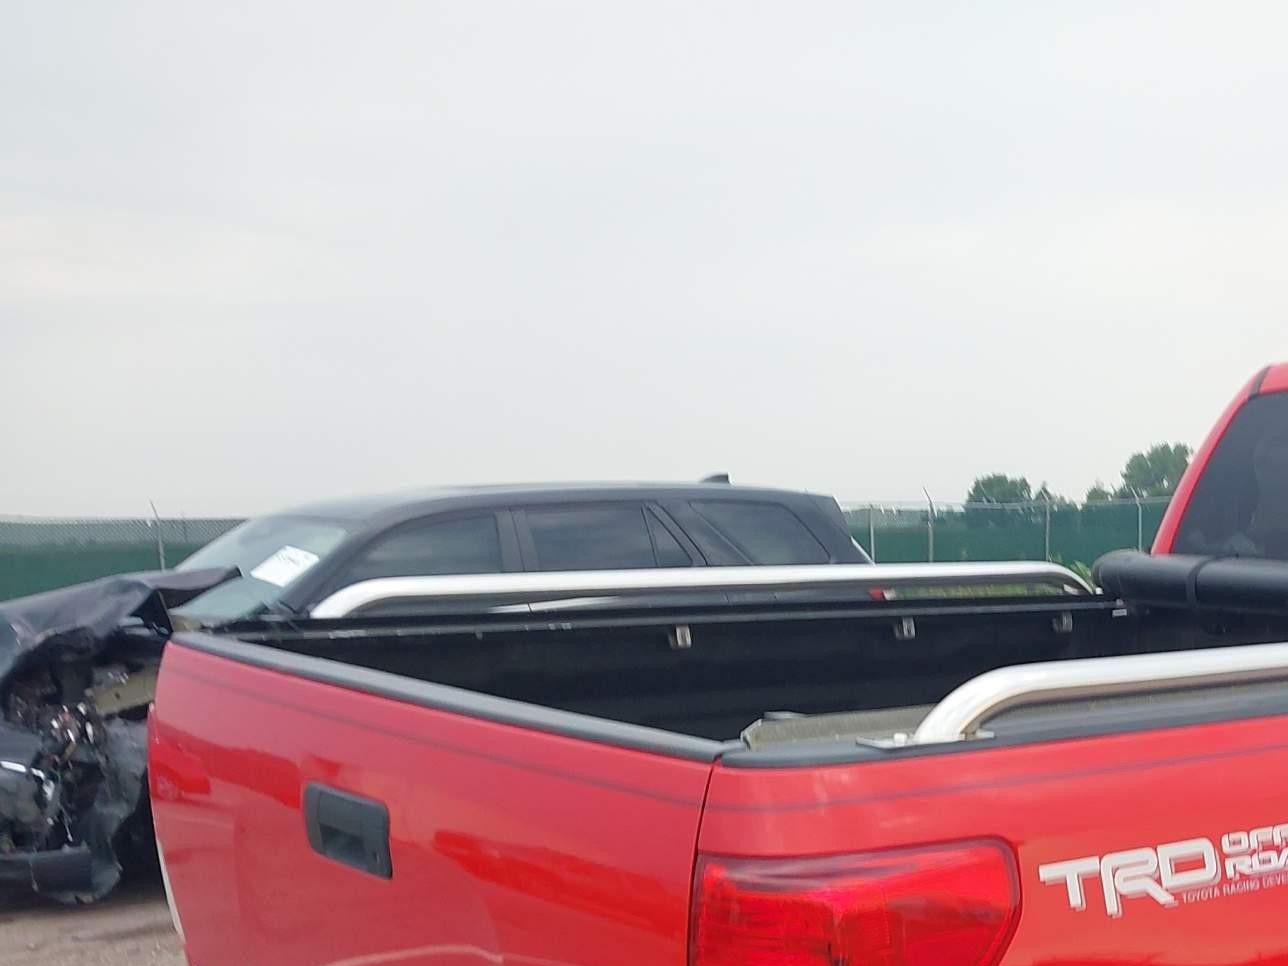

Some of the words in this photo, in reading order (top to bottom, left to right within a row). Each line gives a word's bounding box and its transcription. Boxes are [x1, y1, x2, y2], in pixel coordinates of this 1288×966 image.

[1039, 837, 1221, 918] TRD
[1181, 887, 1220, 905] TOYOTA
[1222, 879, 1261, 898] RACING
